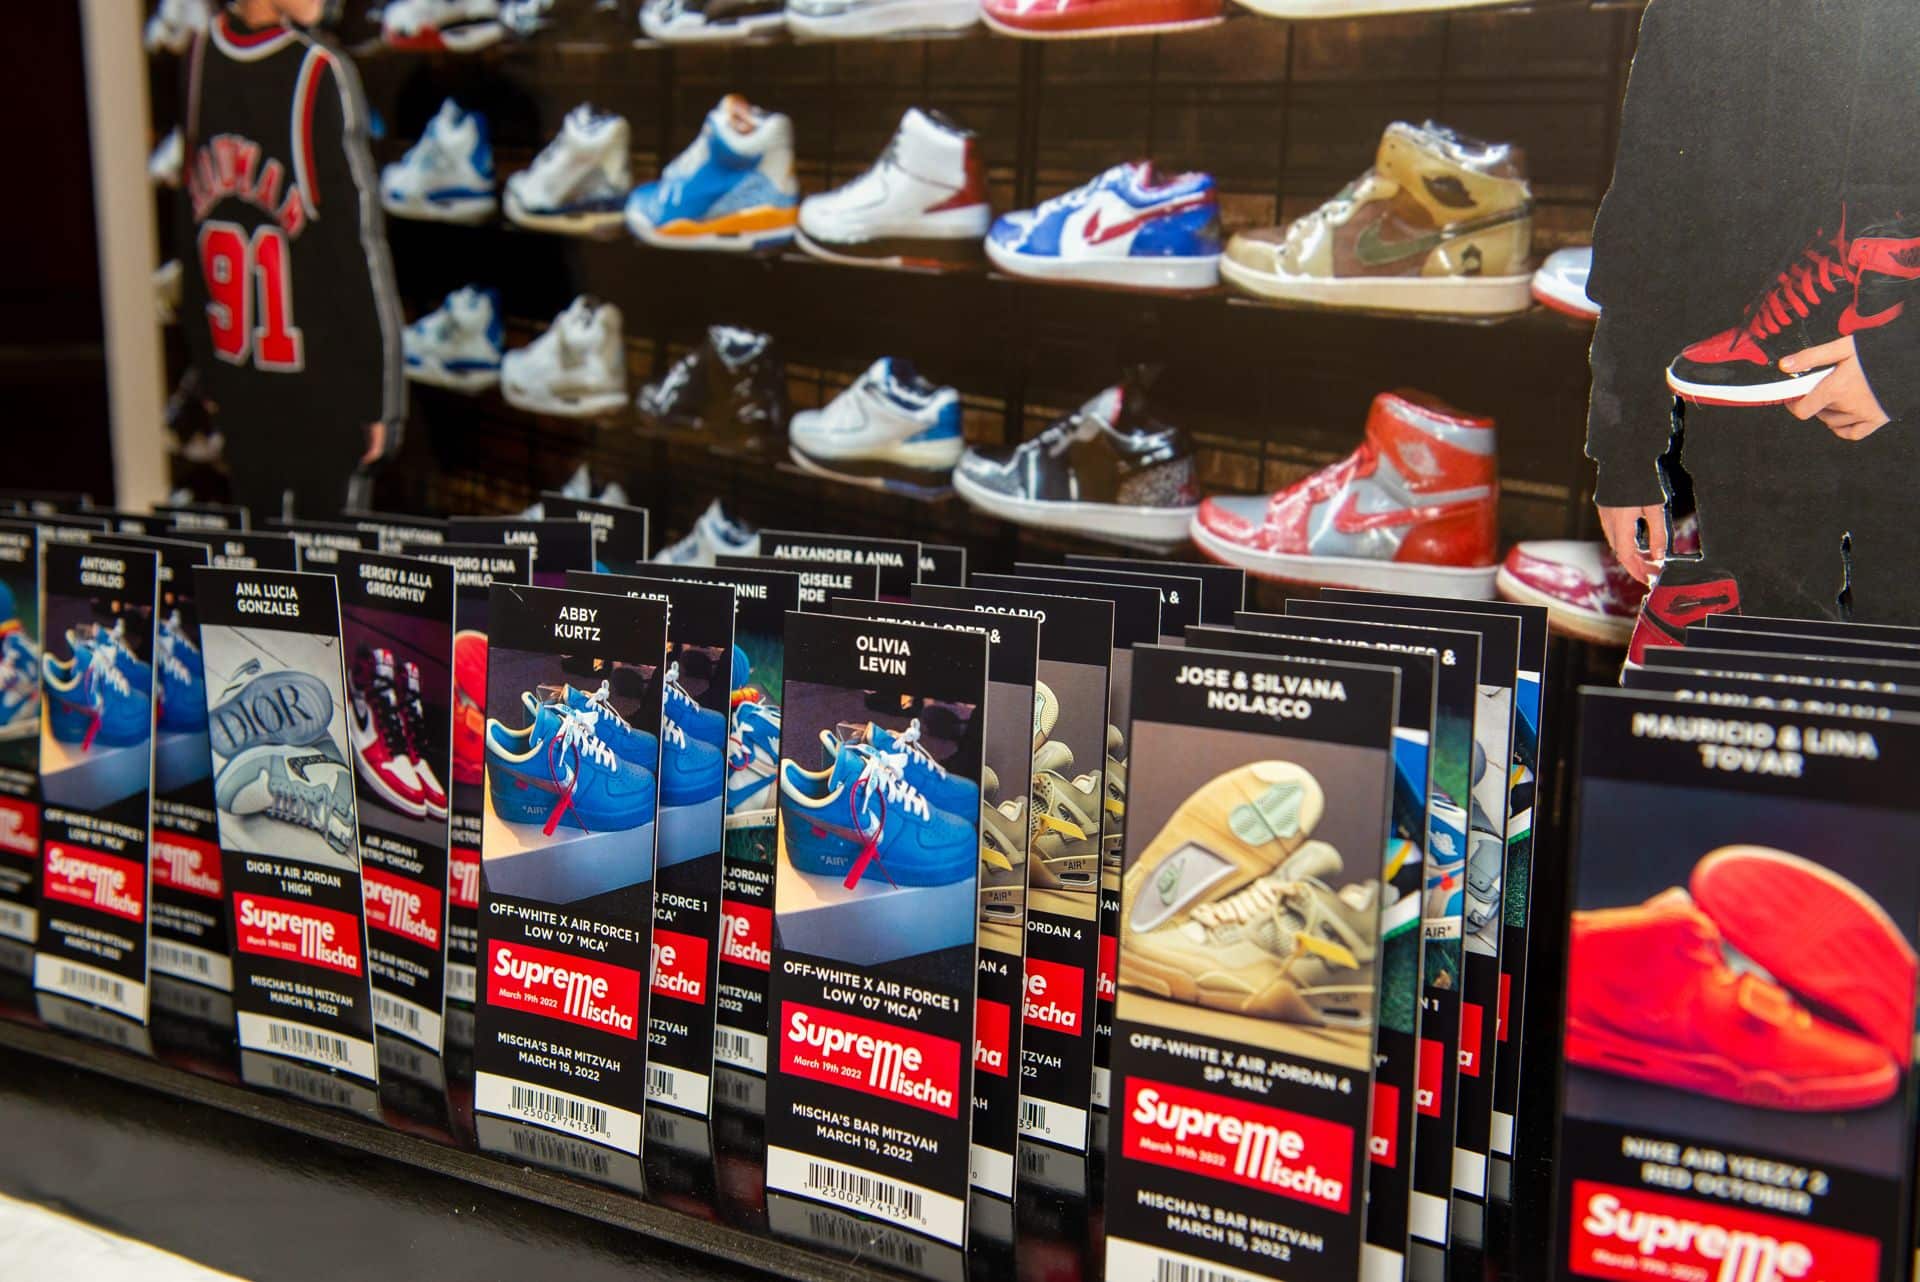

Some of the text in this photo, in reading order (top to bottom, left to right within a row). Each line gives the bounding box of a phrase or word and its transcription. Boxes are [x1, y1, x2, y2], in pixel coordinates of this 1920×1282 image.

[198, 220, 305, 371] 91
[80, 555, 126, 574] ANTONIO
[481, 558, 517, 574] & LINA
[774, 545, 852, 564] ALEXANDER
[855, 551, 863, 564] &
[865, 551, 904, 568] ANNA
[80, 571, 125, 590] GIRALDO
[360, 564, 432, 588] SERGEY & ALLA
[801, 573, 853, 589] GISELLE
[236, 582, 298, 600] ANA LUCIA
[367, 581, 426, 603] GREGORYEV
[1169, 591, 1180, 604] &
[237, 599, 300, 616] GONZALES
[559, 606, 597, 623] ABBY
[554, 624, 600, 641] KURTZ
[856, 636, 911, 657] OLIVIA
[990, 629, 1001, 644] &
[859, 655, 907, 676] LEVIN
[1441, 649, 1456, 666] &
[1175, 665, 1347, 701] JOSE & SILVANA
[214, 684, 313, 748] DIOR
[1207, 690, 1312, 719] NOLASCO
[1632, 712, 1879, 760] MAURICIO & LINA
[1698, 743, 1805, 778] TOVAR
[381, 840, 412, 858] JORDAN
[48, 848, 126, 890] Supreme
[246, 860, 341, 888] DIOR X AIR JORDAN
[729, 867, 769, 884] JORDAN
[94, 884, 142, 916] Mischa
[281, 880, 312, 896] 1 HIGH
[364, 879, 420, 914] preme
[662, 893, 708, 912] FORCE 1
[240, 898, 335, 942] Supreme
[388, 908, 438, 943] Mischa
[490, 902, 640, 944] OFF-WHITE X AIR FORCE 1
[1027, 921, 1082, 940] ORDAN 4
[301, 935, 357, 970] Mischa
[524, 925, 609, 953] LOW '07 'MCA'
[493, 948, 609, 999] Supreme
[654, 964, 701, 996] ischa
[1000, 963, 1008, 977] 4
[295, 983, 313, 997] BAR
[315, 988, 353, 1008] MITZVAH
[499, 987, 558, 1009] March 19th 2022
[718, 983, 762, 1004] MITZVAH
[783, 961, 959, 1013] OFF-WHITE X AIR FORCE 1
[270, 991, 339, 1017] MARCH 2022
[563, 992, 633, 1031] Mischa
[718, 997, 743, 1013] 2022
[823, 986, 922, 1021] LOW '07 'MCA'
[1024, 997, 1076, 1027] ischa
[650, 1018, 688, 1037] ITZVAH
[788, 1011, 923, 1071] Supreme
[497, 1031, 621, 1073] MISCHA'S BAR MITZVAH
[519, 1051, 601, 1082] MARCH 19, 2022
[1022, 1049, 1062, 1069] TZVAH
[1130, 1033, 1352, 1095] OFF-WHITE X AIR JORDAN 4
[793, 1055, 862, 1079] March 19th 2022
[1203, 1065, 1225, 1082] SP
[869, 1064, 952, 1108] Mischa
[792, 1103, 938, 1154] MISCHA'S BAR MITZVAH
[1132, 1088, 1304, 1160] Supreme
[817, 1124, 914, 1163] MARCH 19, 2022
[1139, 1136, 1174, 1154] March
[1199, 1151, 1227, 1168] 2022
[1234, 1148, 1343, 1202] Mischa
[1621, 1135, 1830, 1196] NIKE AIR YEEZY 2
[822, 1185, 862, 1204] 25002
[869, 1198, 908, 1220] 74135
[1641, 1161, 1813, 1216] RED OCTOBER
[1137, 1189, 1324, 1252] MISCHA'S BAR MITZVAH
[1166, 1216, 1225, 1243] MARCH
[1250, 1237, 1292, 1262] 2022
[1582, 1193, 1814, 1279] Supreme
